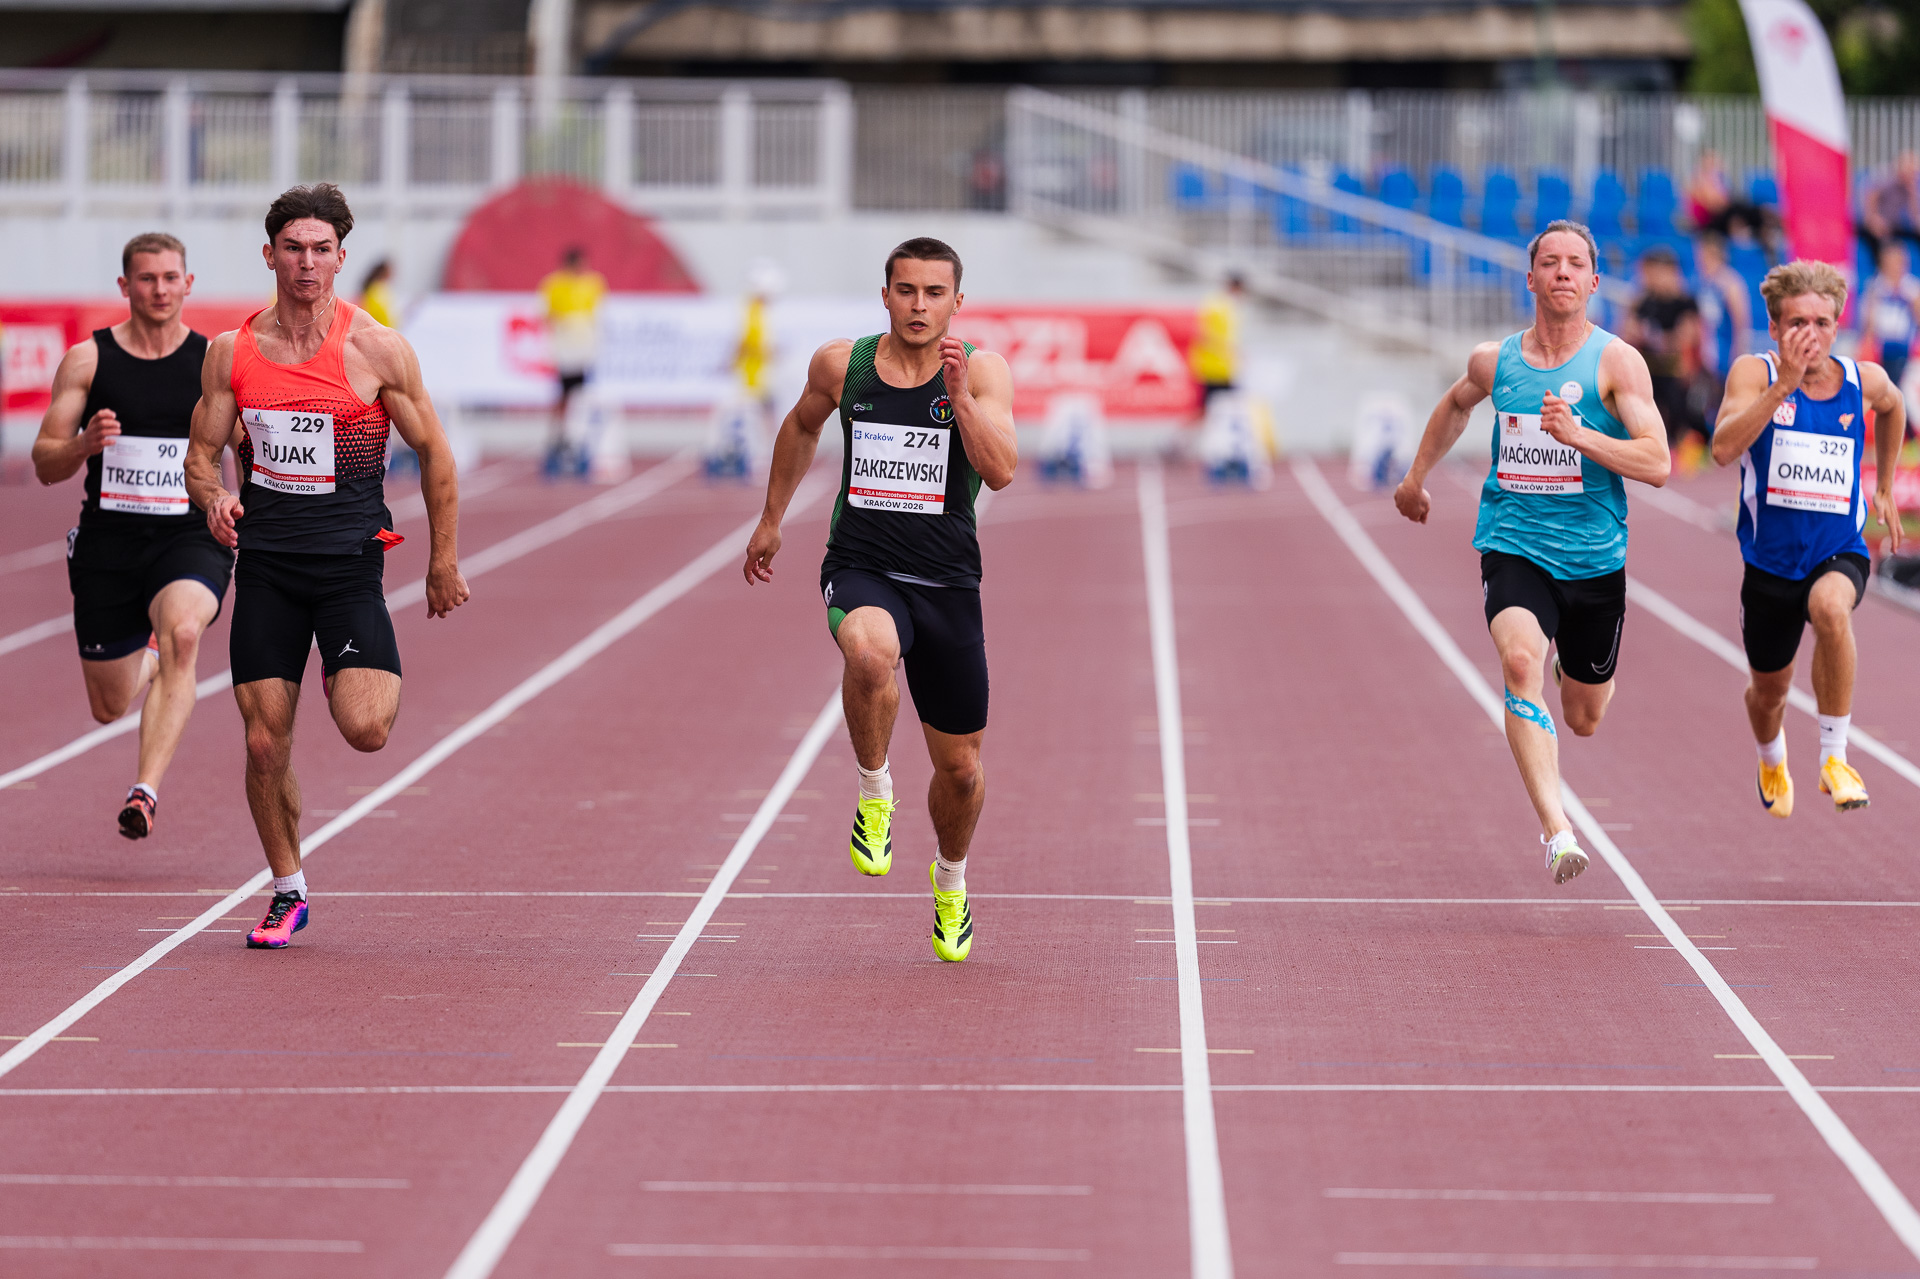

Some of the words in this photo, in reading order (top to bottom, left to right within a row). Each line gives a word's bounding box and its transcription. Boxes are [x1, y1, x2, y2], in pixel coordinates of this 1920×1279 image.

[291, 416, 324, 433] 229
[864, 432, 894, 441] Kraków
[904, 432, 940, 449] 274
[158, 444, 177, 458] 90
[262, 440, 316, 464] FUJAK
[1500, 443, 1577, 466] MAĆKOWIAK
[1820, 440, 1847, 456] 329
[106, 466, 183, 486] TRZECIAK
[854, 458, 943, 483] ZAKRZEWSKI
[1778, 463, 1845, 485] ORMAN
[264, 478, 293, 491] KRAKÓW
[1511, 483, 1543, 491] KRAKÓW
[876, 490, 907, 498] Mistrzostwa
[864, 499, 900, 508] KRAKÓW
